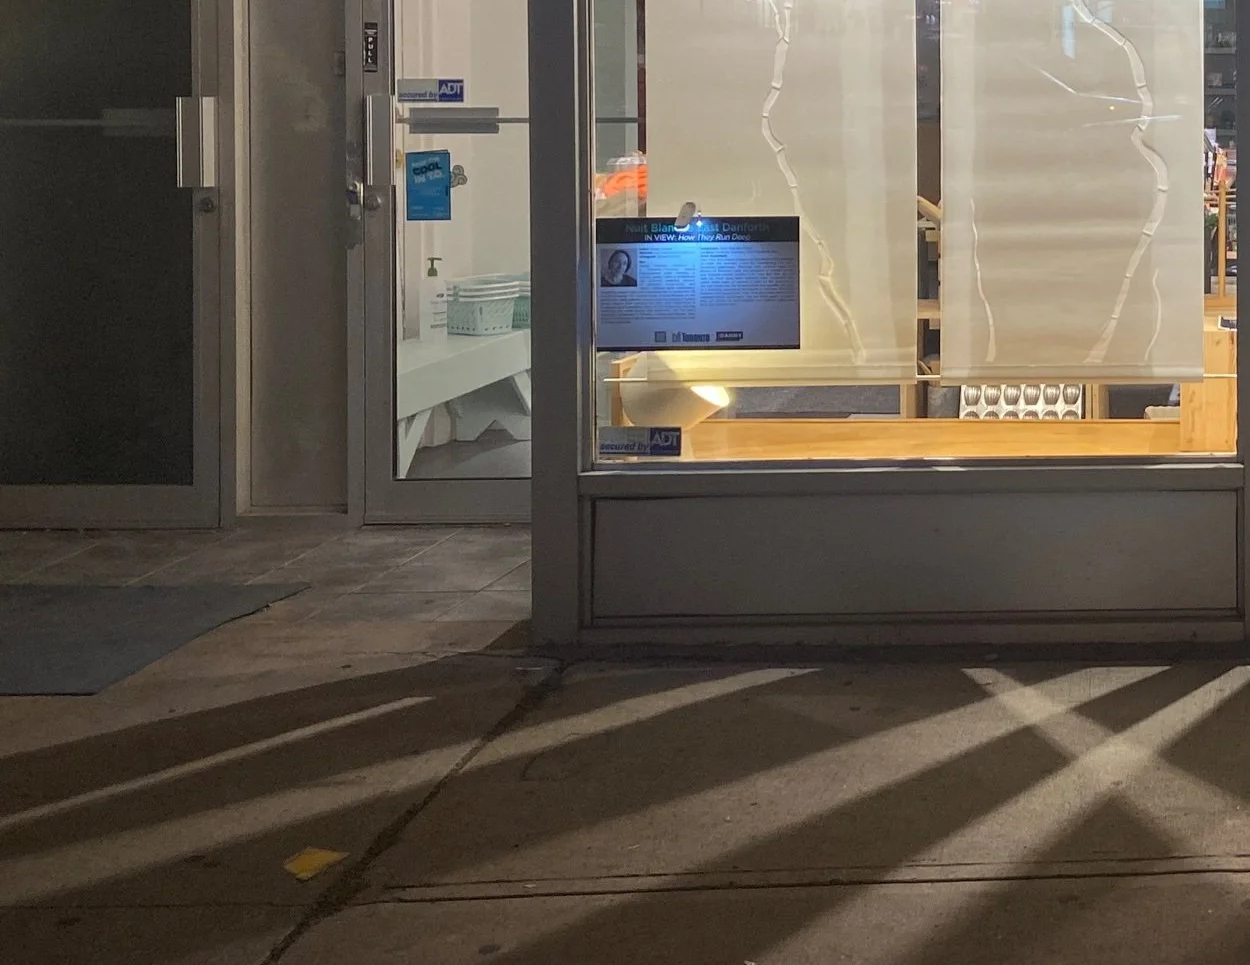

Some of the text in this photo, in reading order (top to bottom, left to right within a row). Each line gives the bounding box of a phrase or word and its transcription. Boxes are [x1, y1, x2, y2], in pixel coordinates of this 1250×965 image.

[439, 82, 463, 95] ADT
[412, 162, 442, 176] COOL
[651, 222, 695, 233] Blan
[722, 222, 770, 233] Danforth
[678, 233, 695, 241] How
[715, 233, 731, 241] Run
[651, 431, 680, 447] ADT
